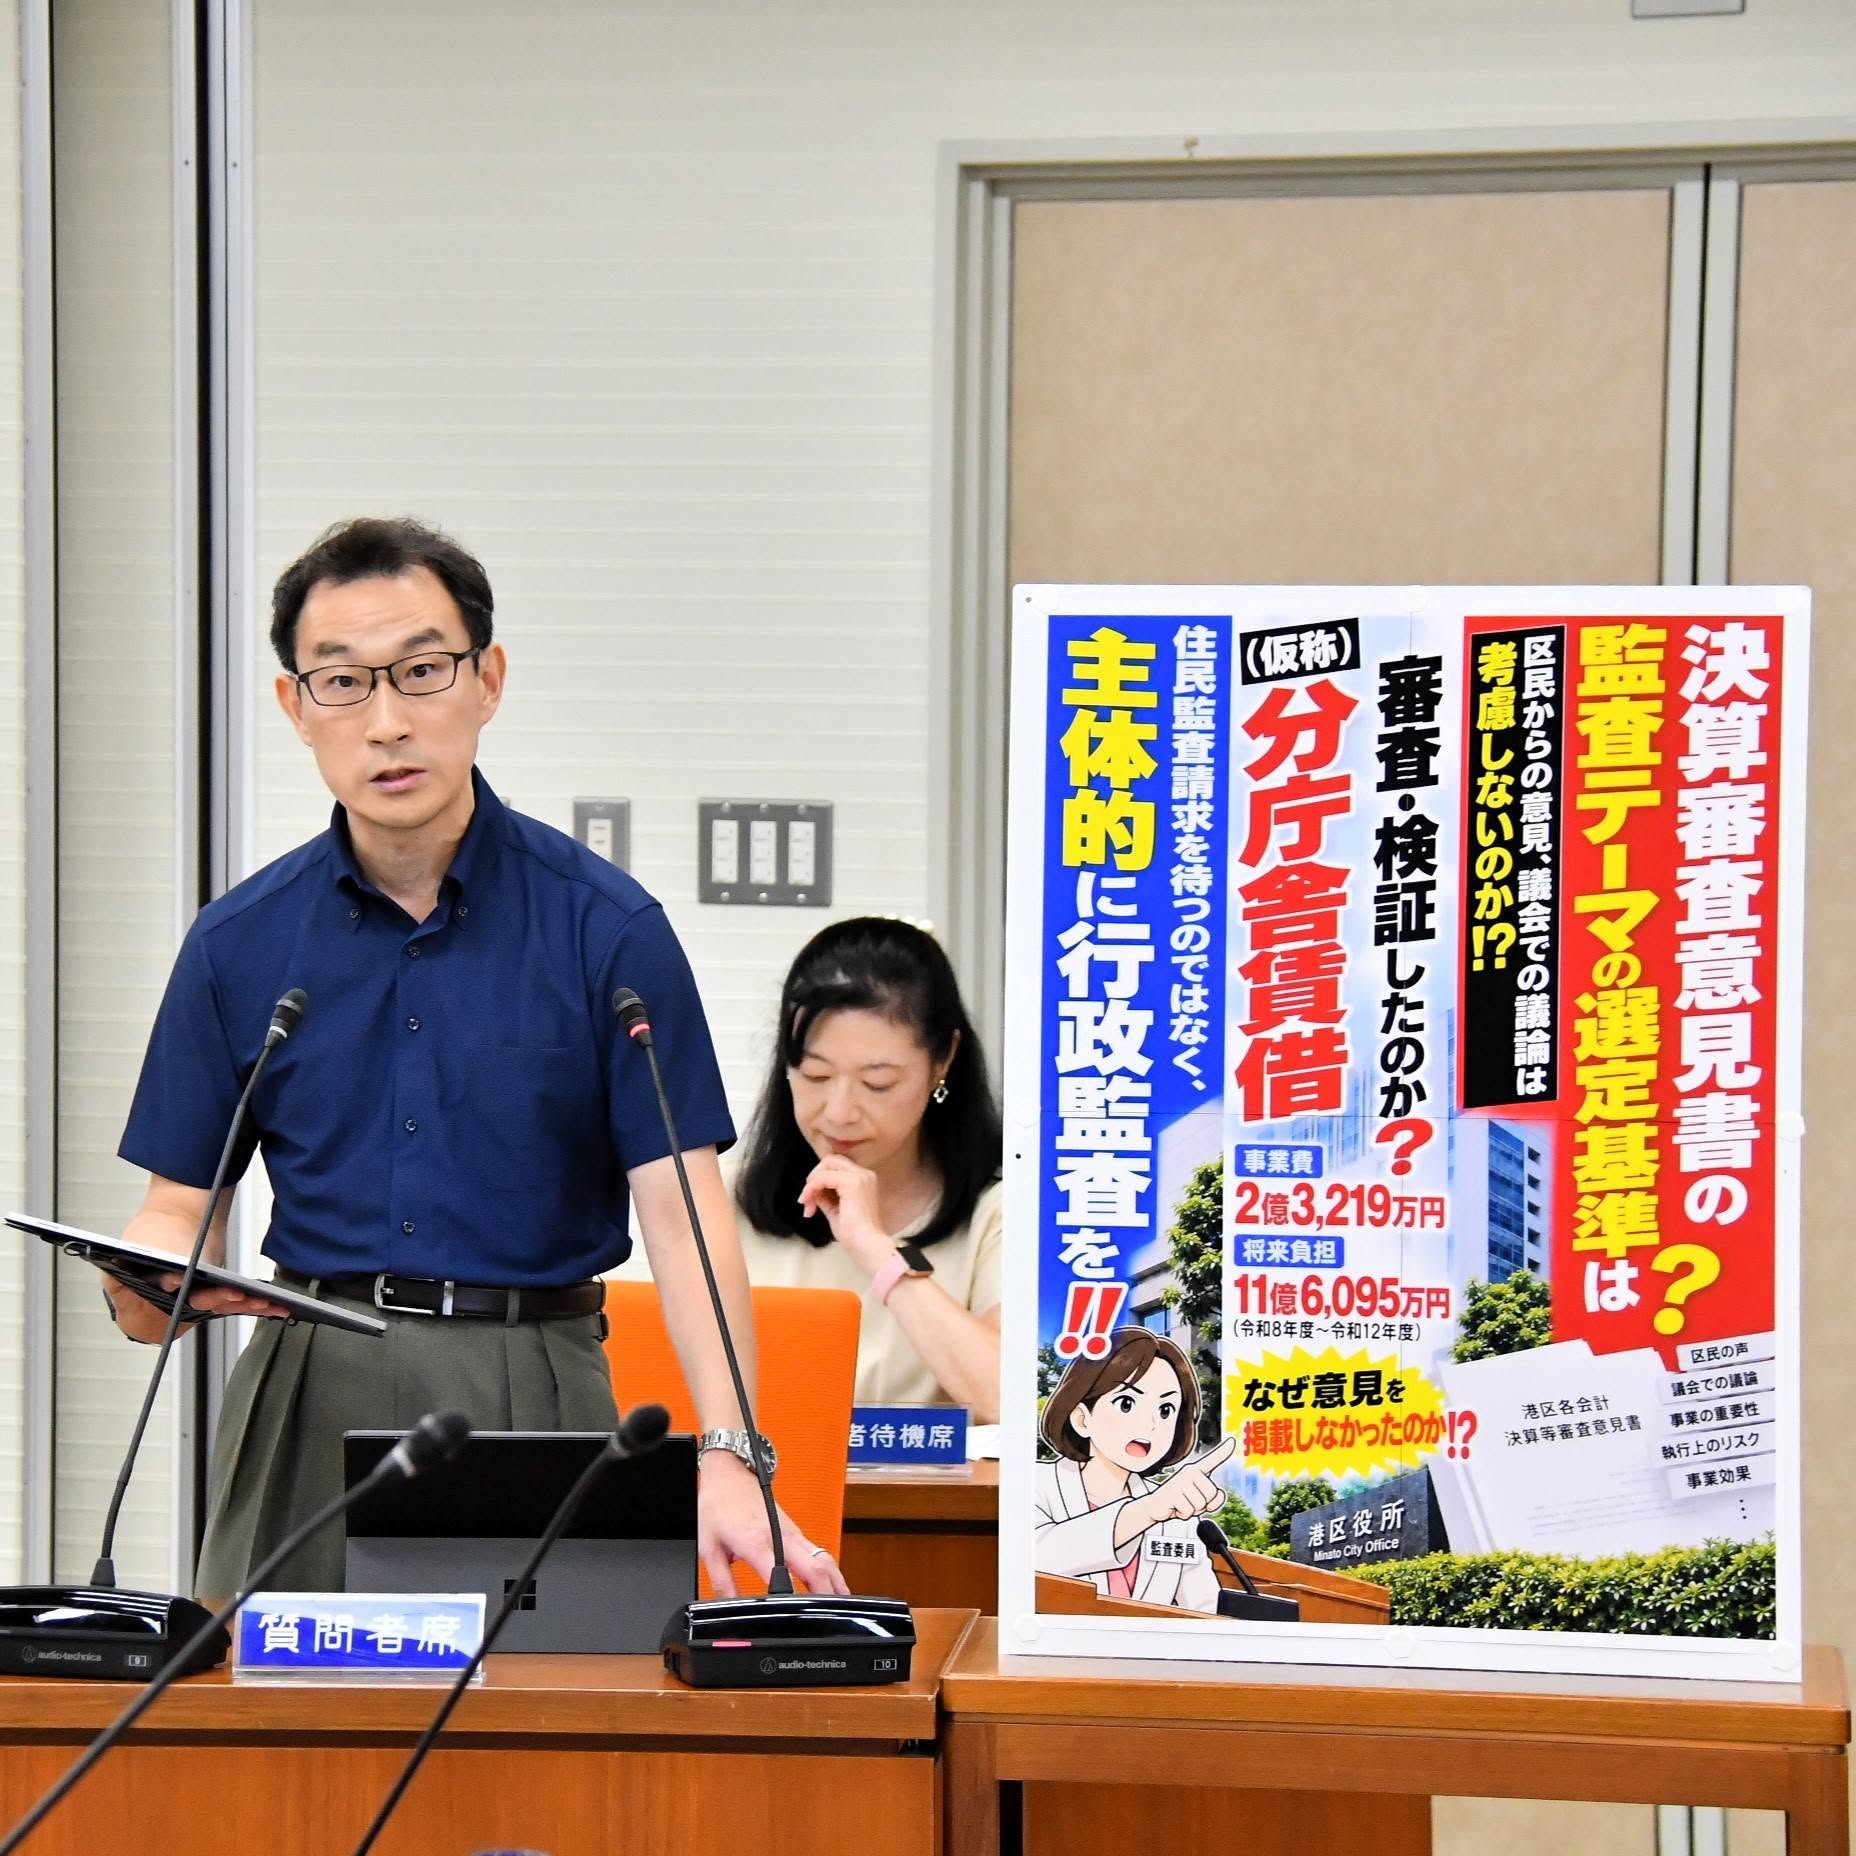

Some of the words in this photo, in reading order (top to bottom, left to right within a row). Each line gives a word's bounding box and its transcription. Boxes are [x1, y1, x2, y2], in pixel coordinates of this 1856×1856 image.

[1169, 625, 1217, 1091] 住民監査請求を待つのではなく、
[1514, 634, 1557, 1096] 区民からの意見、議会での議論は
[1672, 622, 1770, 1226] 決算審査意見書の
[1243, 1149, 1314, 1175] 事業費
[1234, 1181, 1445, 1231] 2億3,219万円
[1243, 1238, 1336, 1264] 将来負担
[1234, 1273, 1450, 1319] 11億6,095万円
[1691, 1342, 1749, 1364] 区民の声
[1243, 1370, 1406, 1411] なぜ意見を
[1671, 1371, 1759, 1397] 議会での議論
[1521, 1394, 1609, 1420] 港区各会計
[1669, 1401, 1760, 1428] 事業の重要性
[1504, 1414, 1642, 1447] 決算等審査意見書
[1661, 1432, 1760, 1460] 執行上のリスク
[1686, 1465, 1752, 1489] 事業効果
[1308, 1498, 1406, 1548] 港区役所
[1150, 1541, 1196, 1560] 監査委員
[1313, 1547, 1342, 1562] Minato
[1343, 1543, 1363, 1559] City
[1365, 1537, 1400, 1553] Office
[258, 1614, 461, 1655] 質問者席
[38, 1649, 102, 1663] audio-technica
[778, 1659, 847, 1670] audio-technica
[880, 1660, 892, 1669] 10
